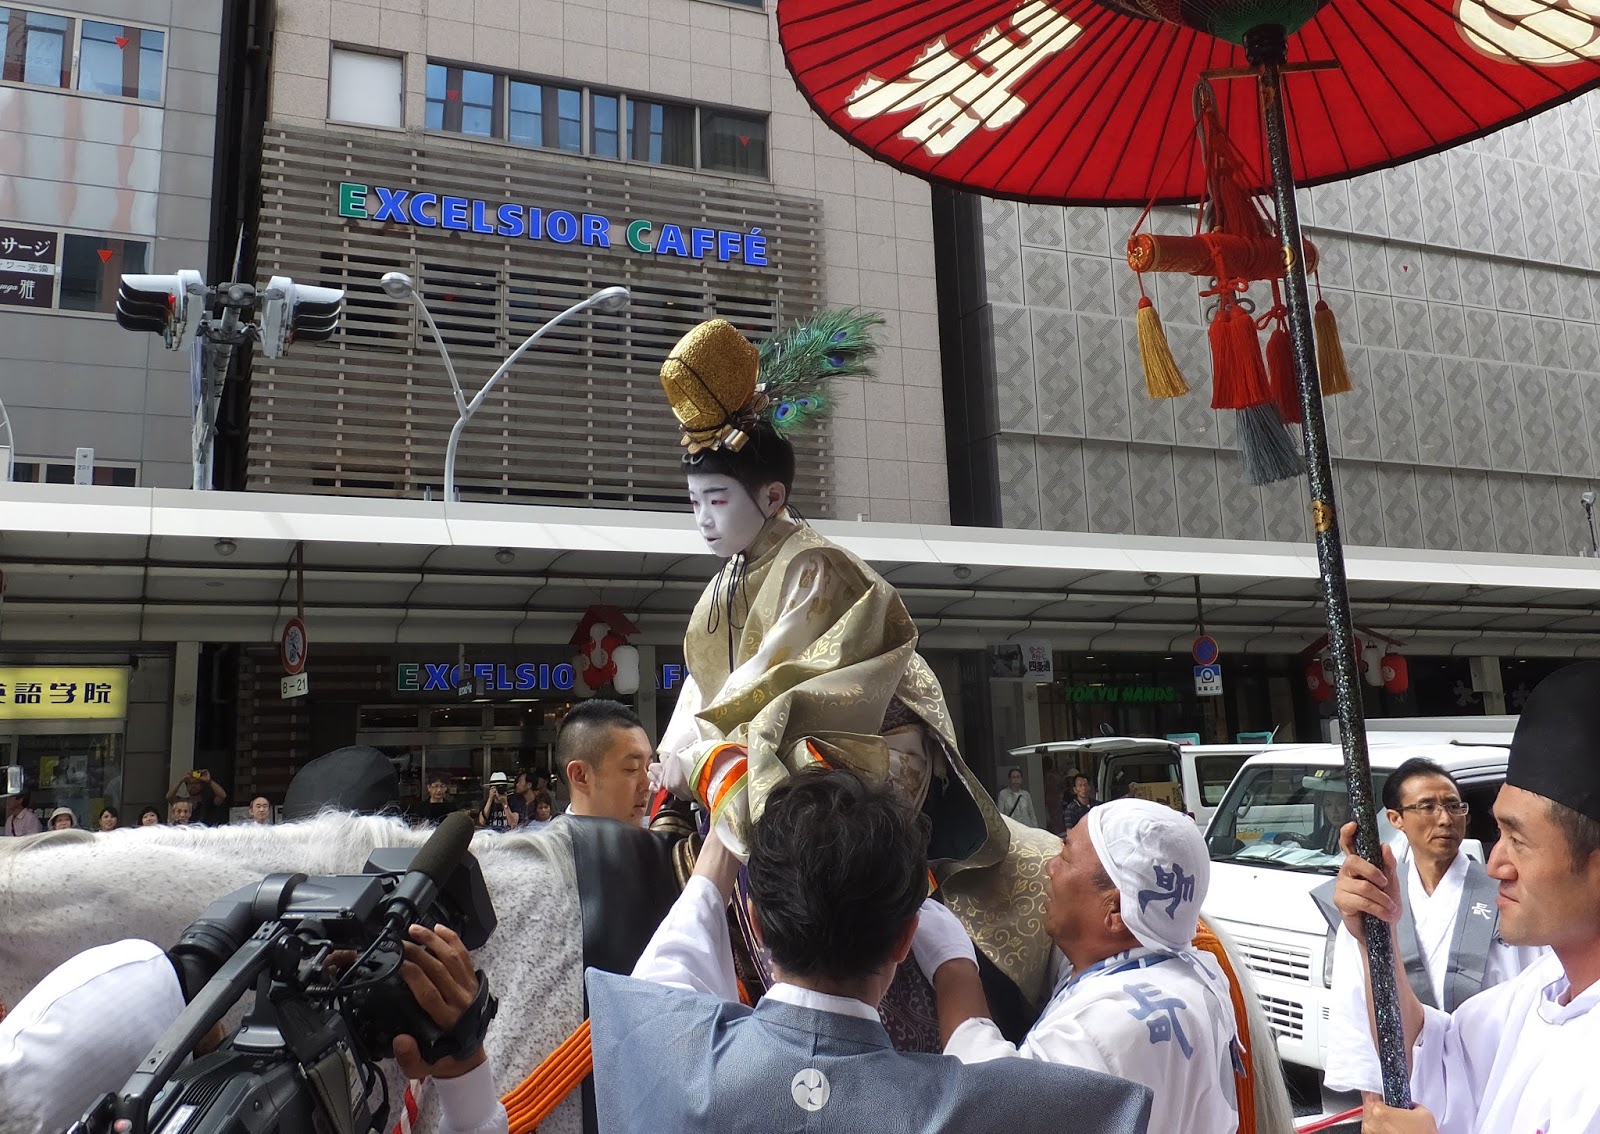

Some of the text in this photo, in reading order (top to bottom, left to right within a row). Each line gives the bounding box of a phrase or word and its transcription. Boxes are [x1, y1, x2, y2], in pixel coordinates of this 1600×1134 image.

[338, 181, 769, 267] EXCELSIOR CAFFÉ
[1, 236, 51, 257] サージ
[397, 663, 575, 691] EXCELSIO
[0, 682, 112, 704] 語学院
[1064, 686, 1177, 702] TOKYU HANDS
[1471, 901, 1492, 920] 長
